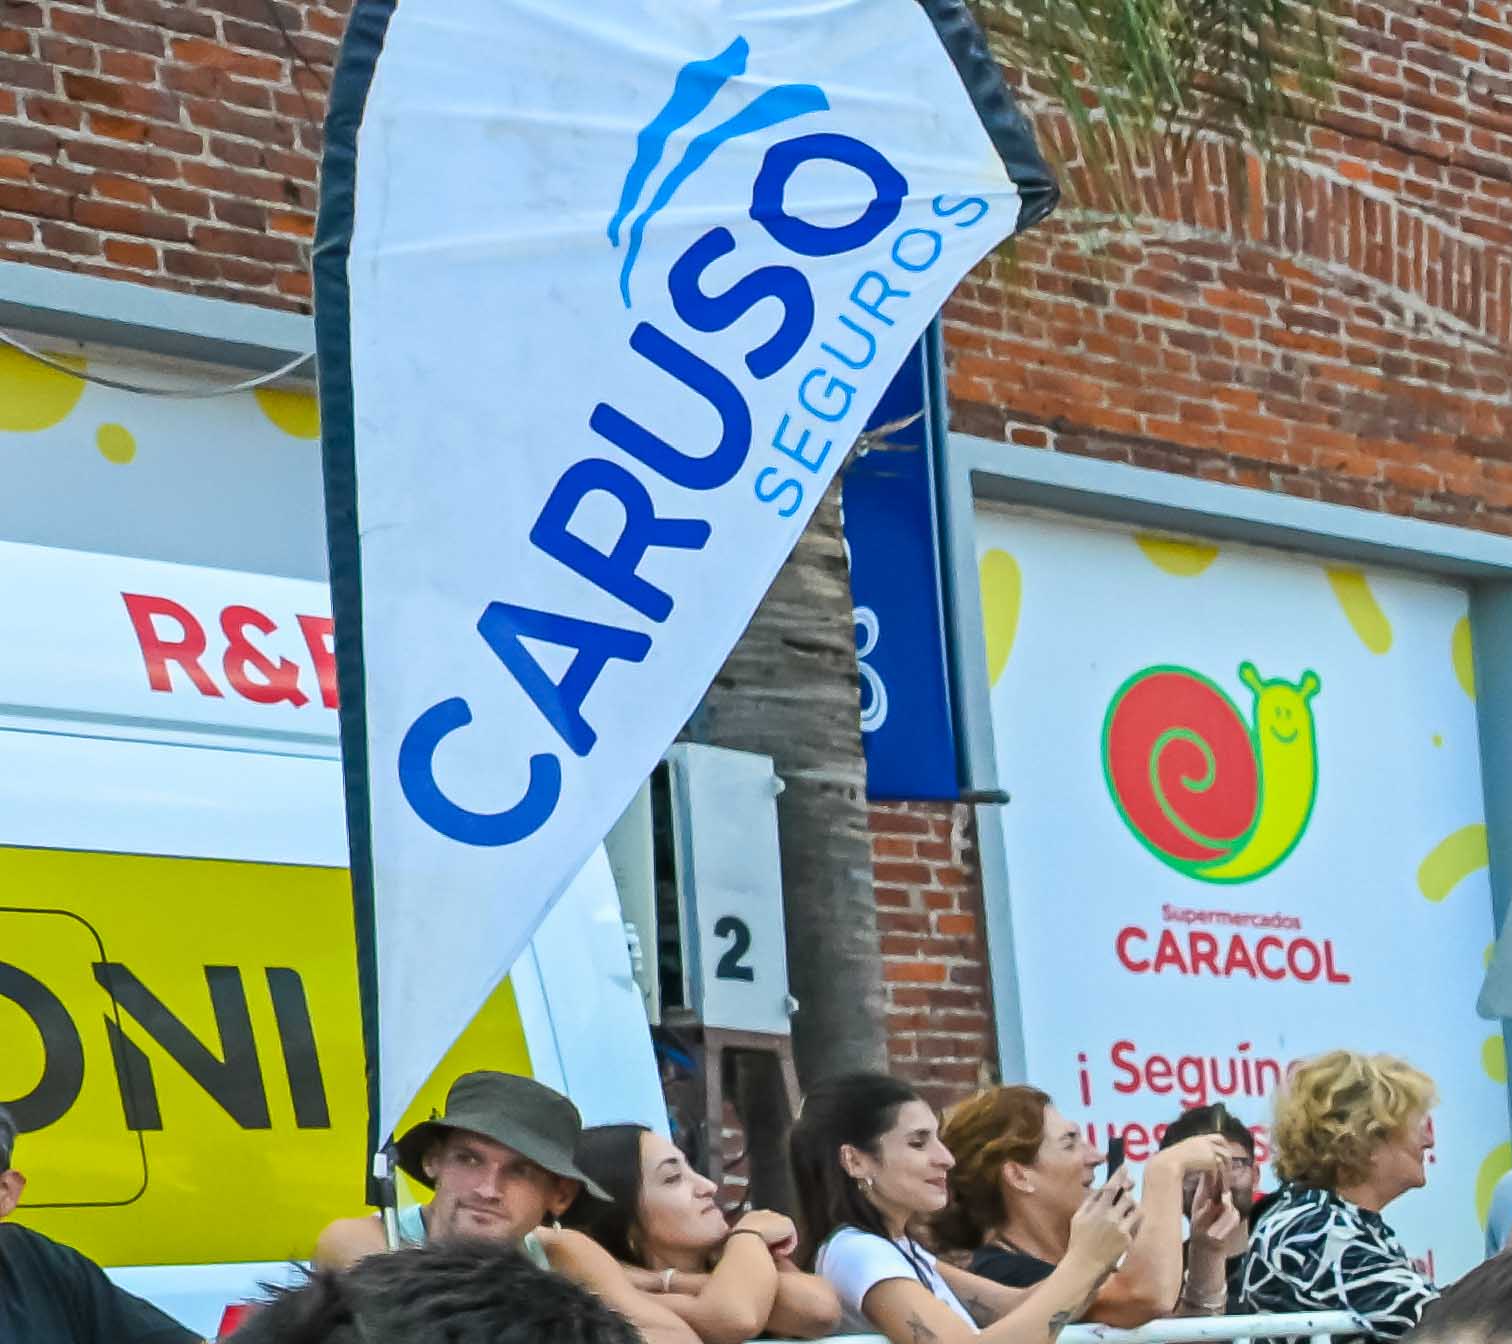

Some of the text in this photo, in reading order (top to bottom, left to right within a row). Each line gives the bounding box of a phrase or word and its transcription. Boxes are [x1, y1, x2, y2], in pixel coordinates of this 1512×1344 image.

[754, 192, 990, 518] SEGUROS
[399, 131, 909, 848] CARUSO
[713, 916, 754, 983] 2
[1115, 926, 1351, 983] CARACOL
